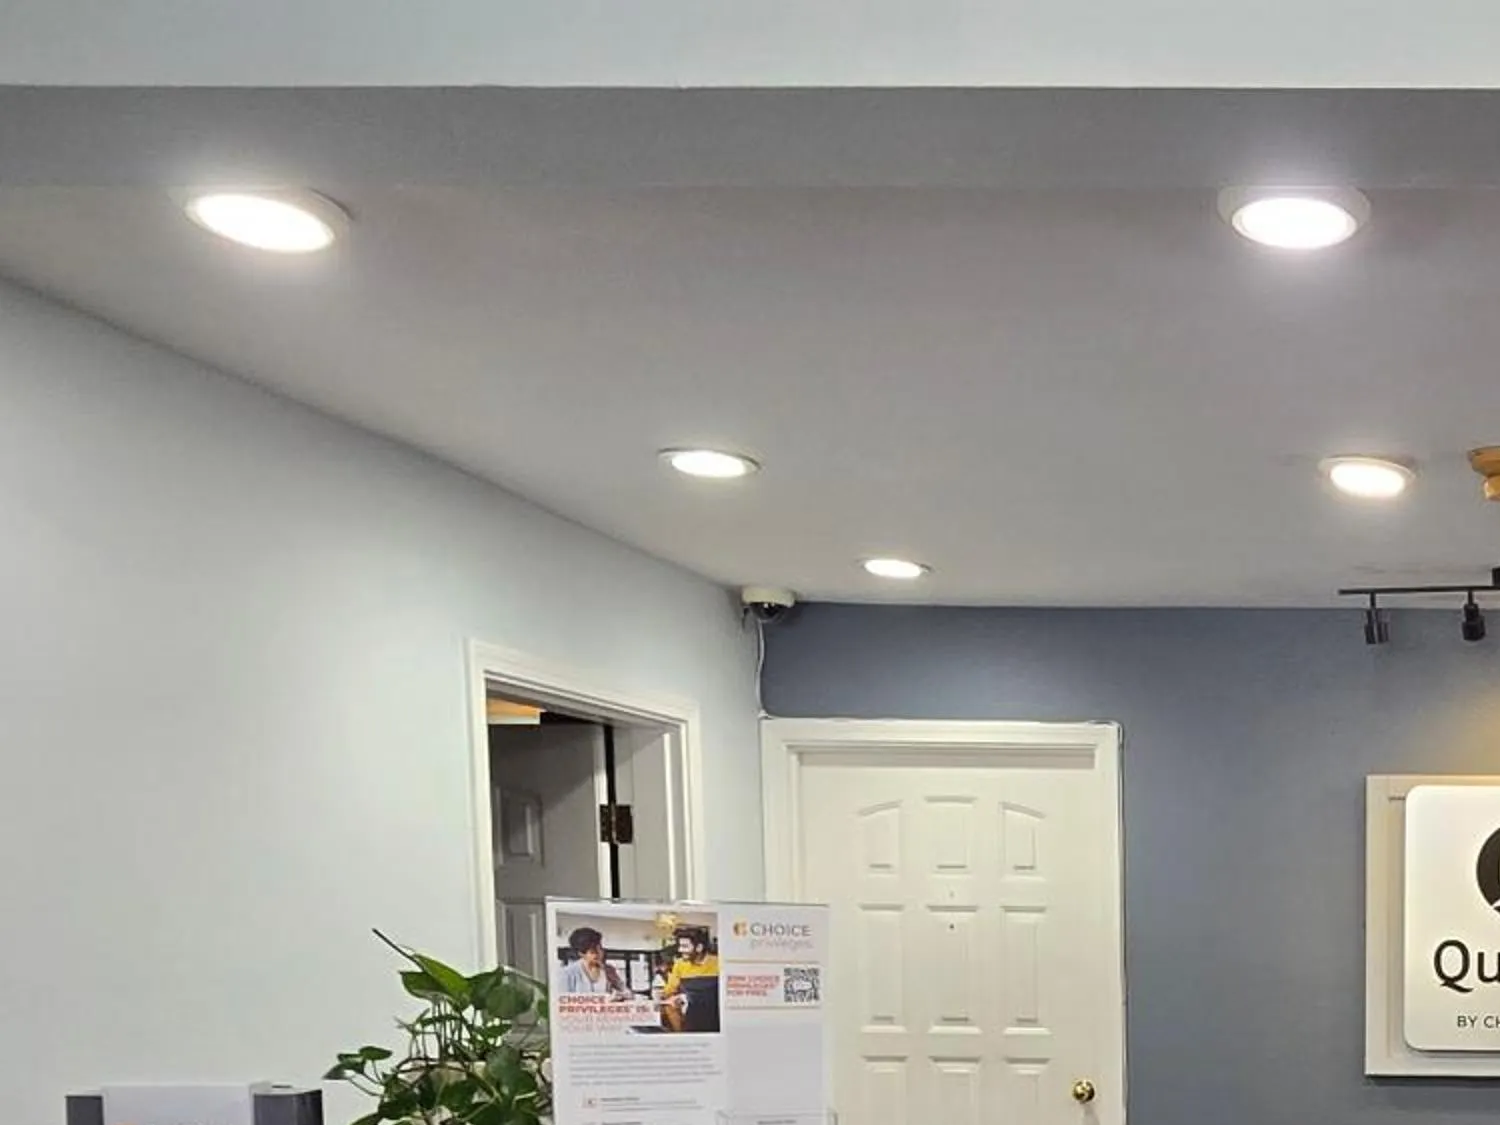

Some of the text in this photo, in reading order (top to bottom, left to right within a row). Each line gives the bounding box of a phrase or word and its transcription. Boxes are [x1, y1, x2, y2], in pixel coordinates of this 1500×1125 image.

[750, 922, 812, 937] CHOICE
[559, 995, 606, 1005] CHOICE
[1457, 1015, 1477, 1029] BY
